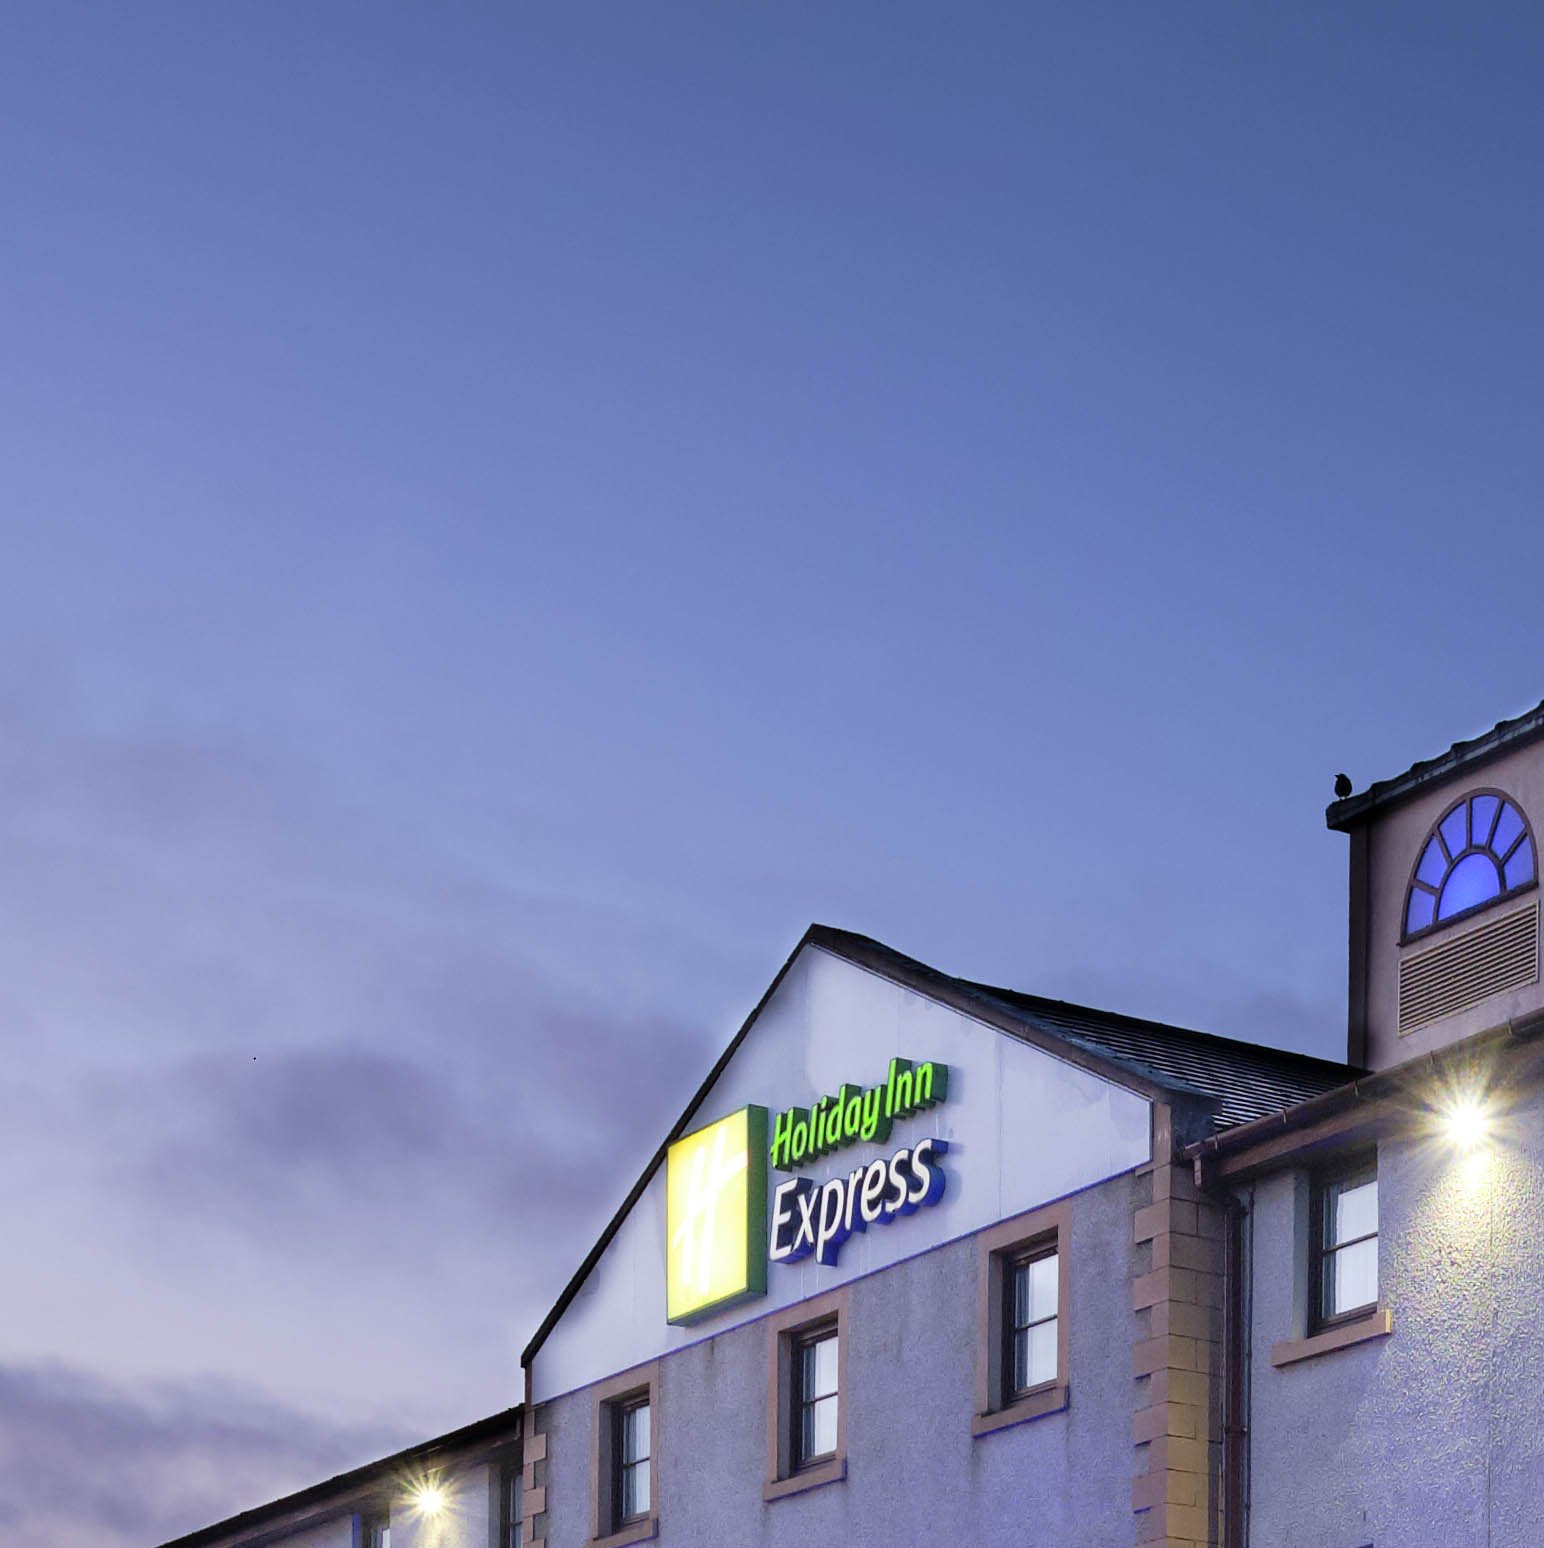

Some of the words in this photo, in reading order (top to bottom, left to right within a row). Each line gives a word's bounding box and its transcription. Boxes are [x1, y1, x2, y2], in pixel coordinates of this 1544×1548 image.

[770, 1084, 884, 1171] Holiday
[886, 1057, 940, 1118] Inn
[770, 1139, 942, 1265] Express
